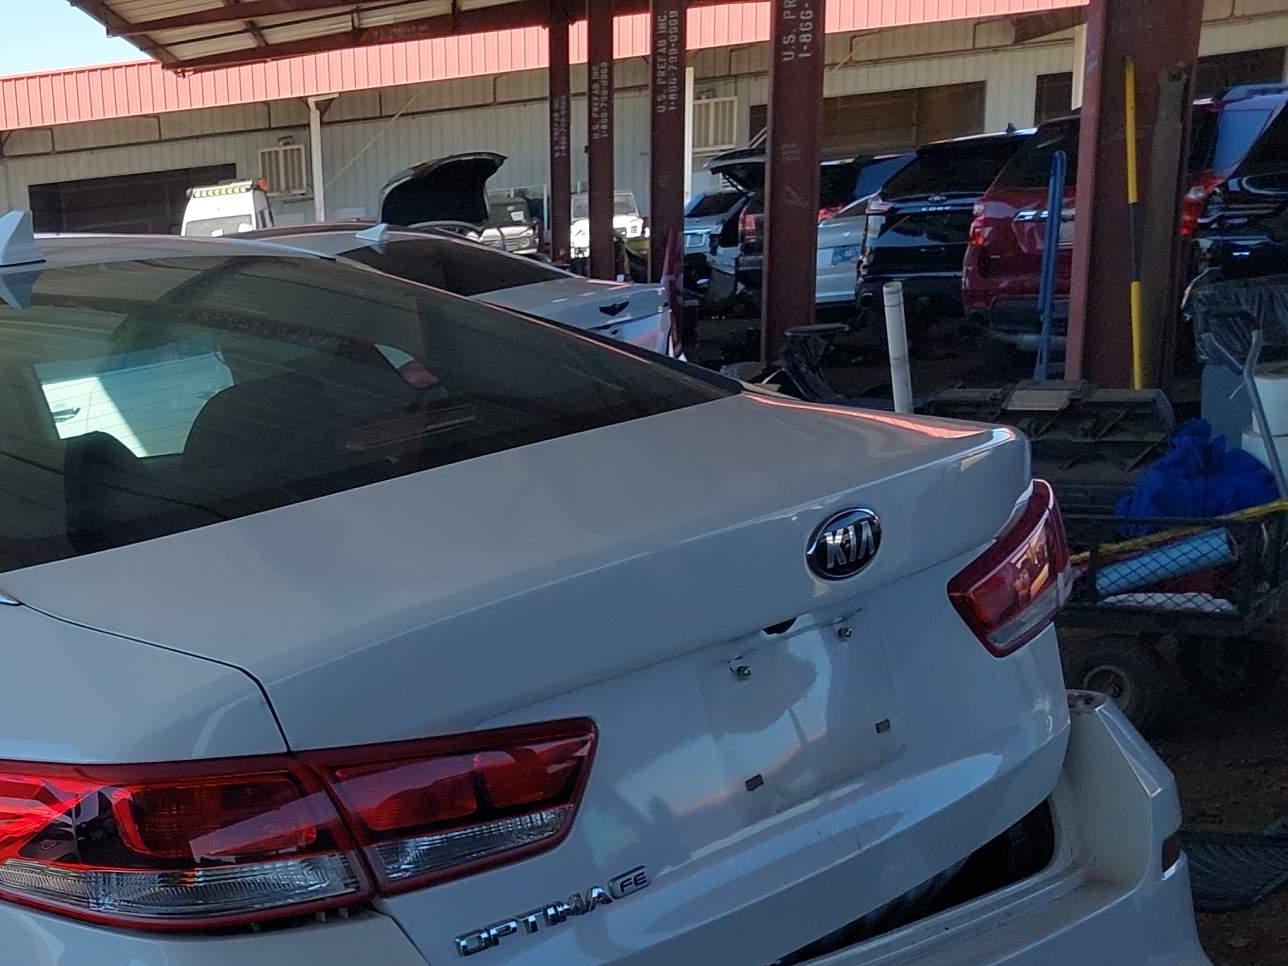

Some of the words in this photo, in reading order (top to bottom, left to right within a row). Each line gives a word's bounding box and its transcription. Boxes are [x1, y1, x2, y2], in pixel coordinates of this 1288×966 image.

[782, 28, 797, 61] U.S.
[824, 520, 875, 569] KIA
[454, 884, 612, 957] OPTIMA
[617, 870, 649, 894] FE
